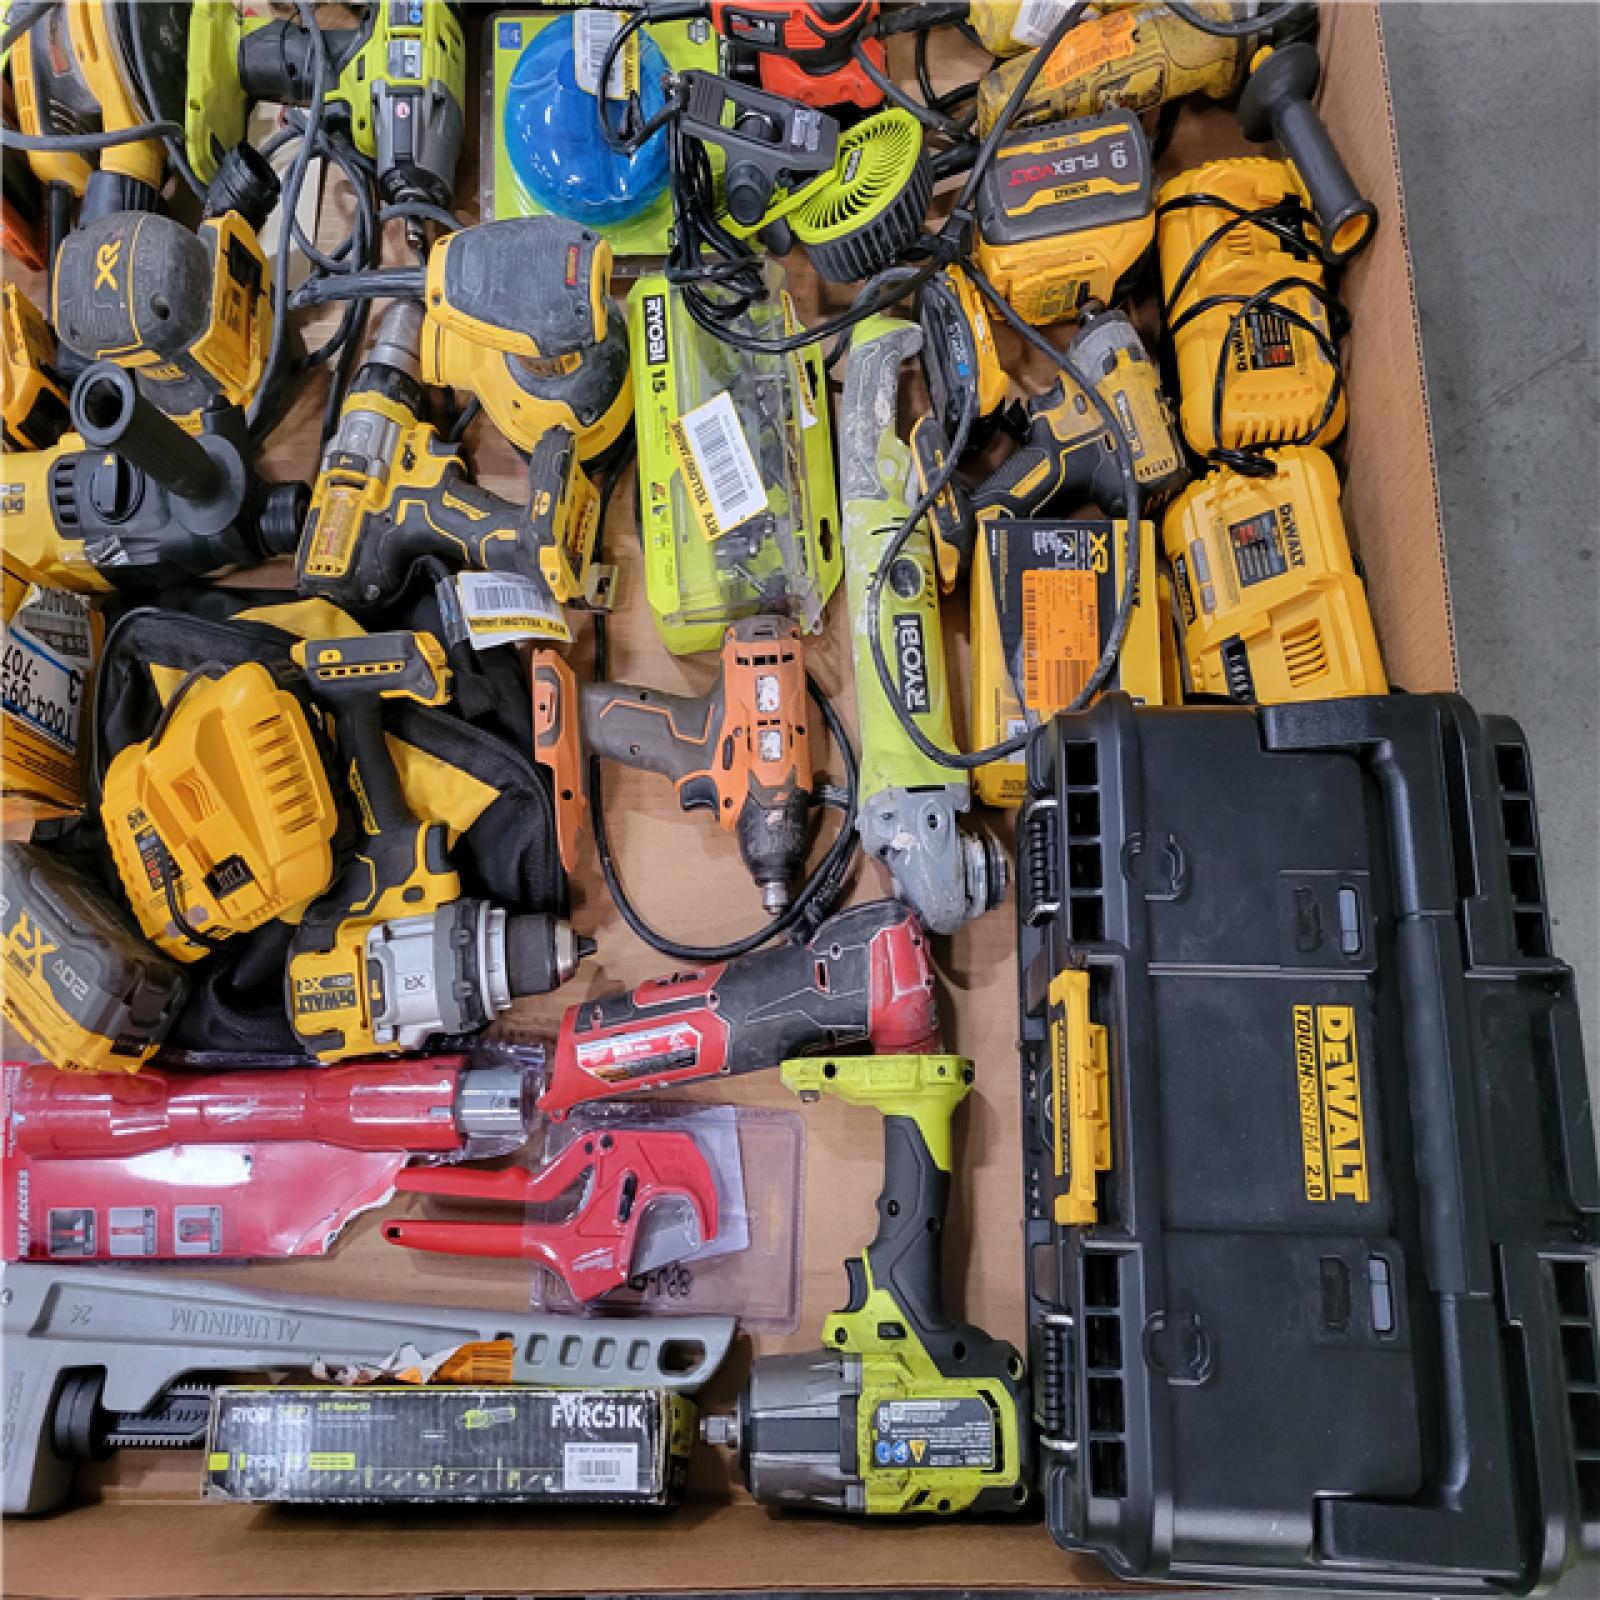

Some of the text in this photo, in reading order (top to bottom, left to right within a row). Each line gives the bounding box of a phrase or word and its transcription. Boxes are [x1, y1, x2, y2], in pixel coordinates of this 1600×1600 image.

[1008, 151, 1099, 188] FLEXVOLT
[647, 298, 667, 361] RYOBI
[900, 620, 926, 710] RYOBI
[1296, 1009, 1323, 1198] TOUGHSYSTEM 2.0
[1319, 1006, 1367, 1201] DEWALT
[19, 1169, 30, 1219] ACCESS
[169, 1306, 301, 1342] ALUMINUM
[551, 1404, 642, 1428] FVRC51K
